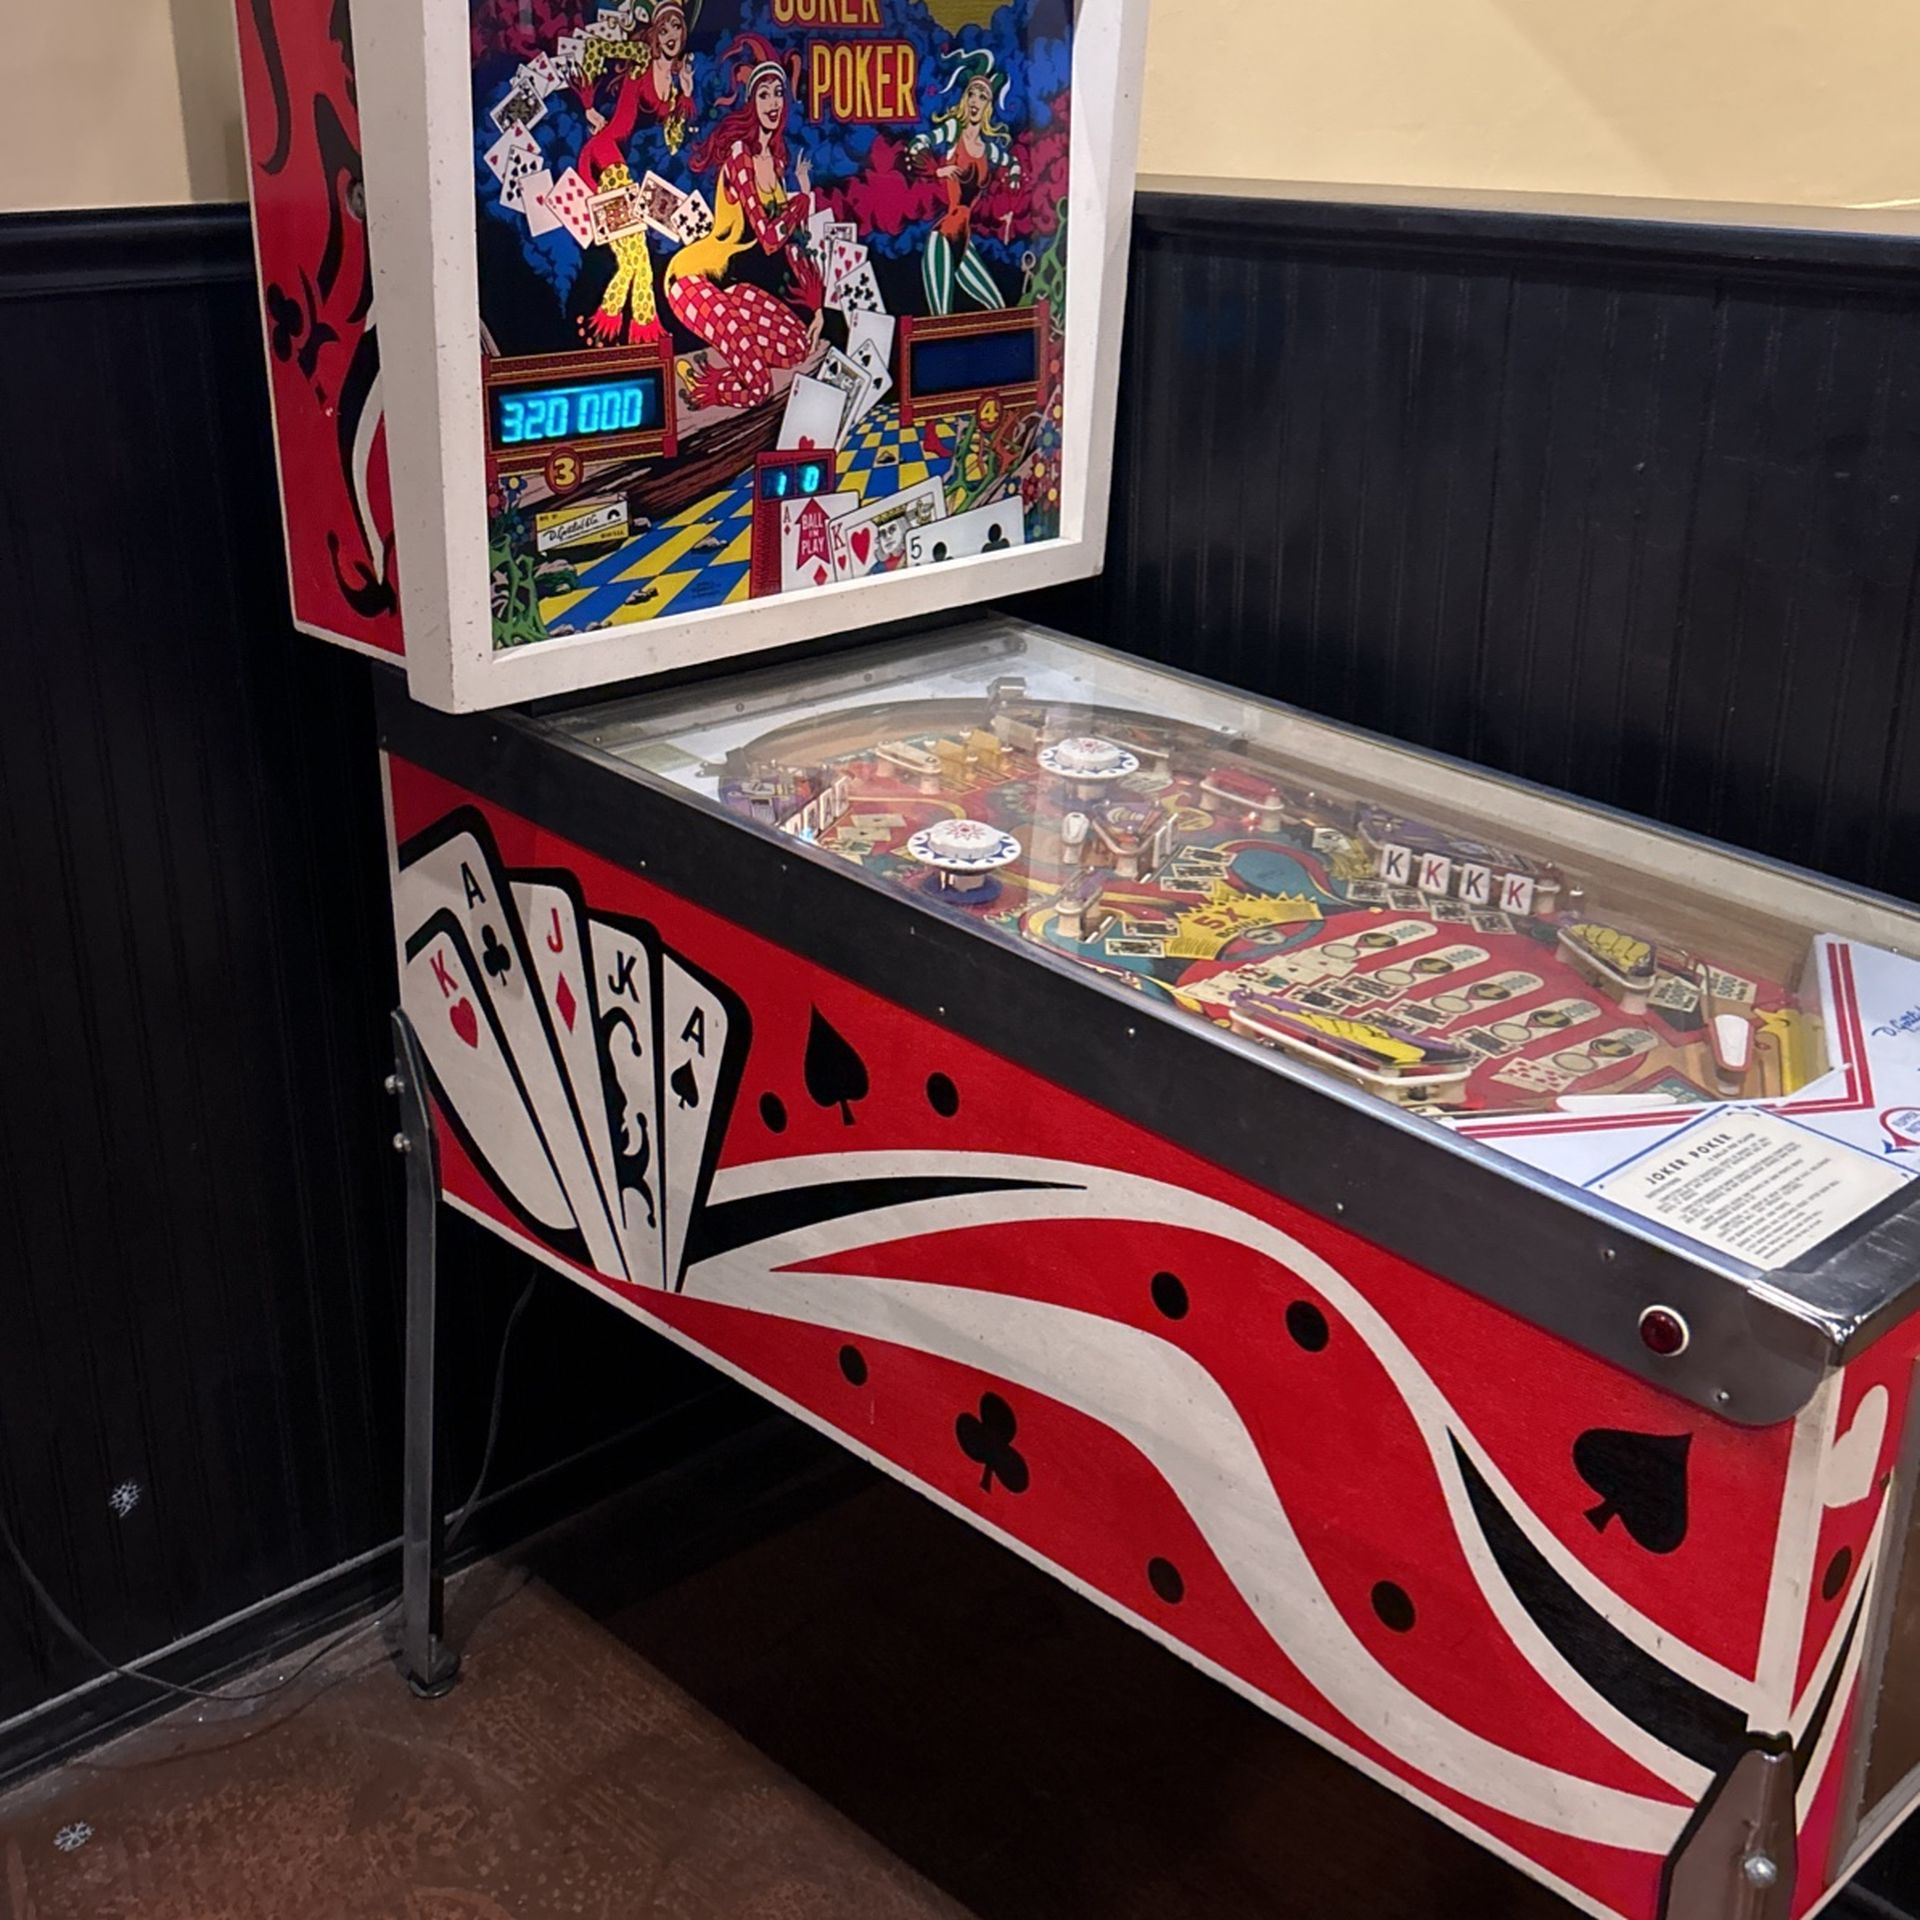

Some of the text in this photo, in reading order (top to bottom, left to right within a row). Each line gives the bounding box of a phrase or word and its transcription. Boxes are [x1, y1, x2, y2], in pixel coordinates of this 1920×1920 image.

[812, 43, 916, 119] POKER
[501, 388, 644, 443] 320 000
[979, 399, 998, 422] 4
[553, 457, 576, 486] 3
[802, 466, 820, 493] 0
[783, 505, 791, 524] A
[801, 512, 824, 531] BALL
[801, 537, 826, 556] PLAY
[808, 530, 819, 538] IN
[831, 522, 846, 551] K
[910, 536, 922, 560] 5
[1386, 850, 1404, 878] K
[1425, 860, 1443, 888] K
[461, 861, 485, 909] A
[1466, 870, 1484, 898] K
[1507, 880, 1525, 908] K
[547, 908, 564, 953] J
[430, 950, 459, 998] K
[681, 1005, 706, 1057] A
[1645, 1158, 1690, 1186] JOKER
[1688, 1132, 1734, 1160] POKER
